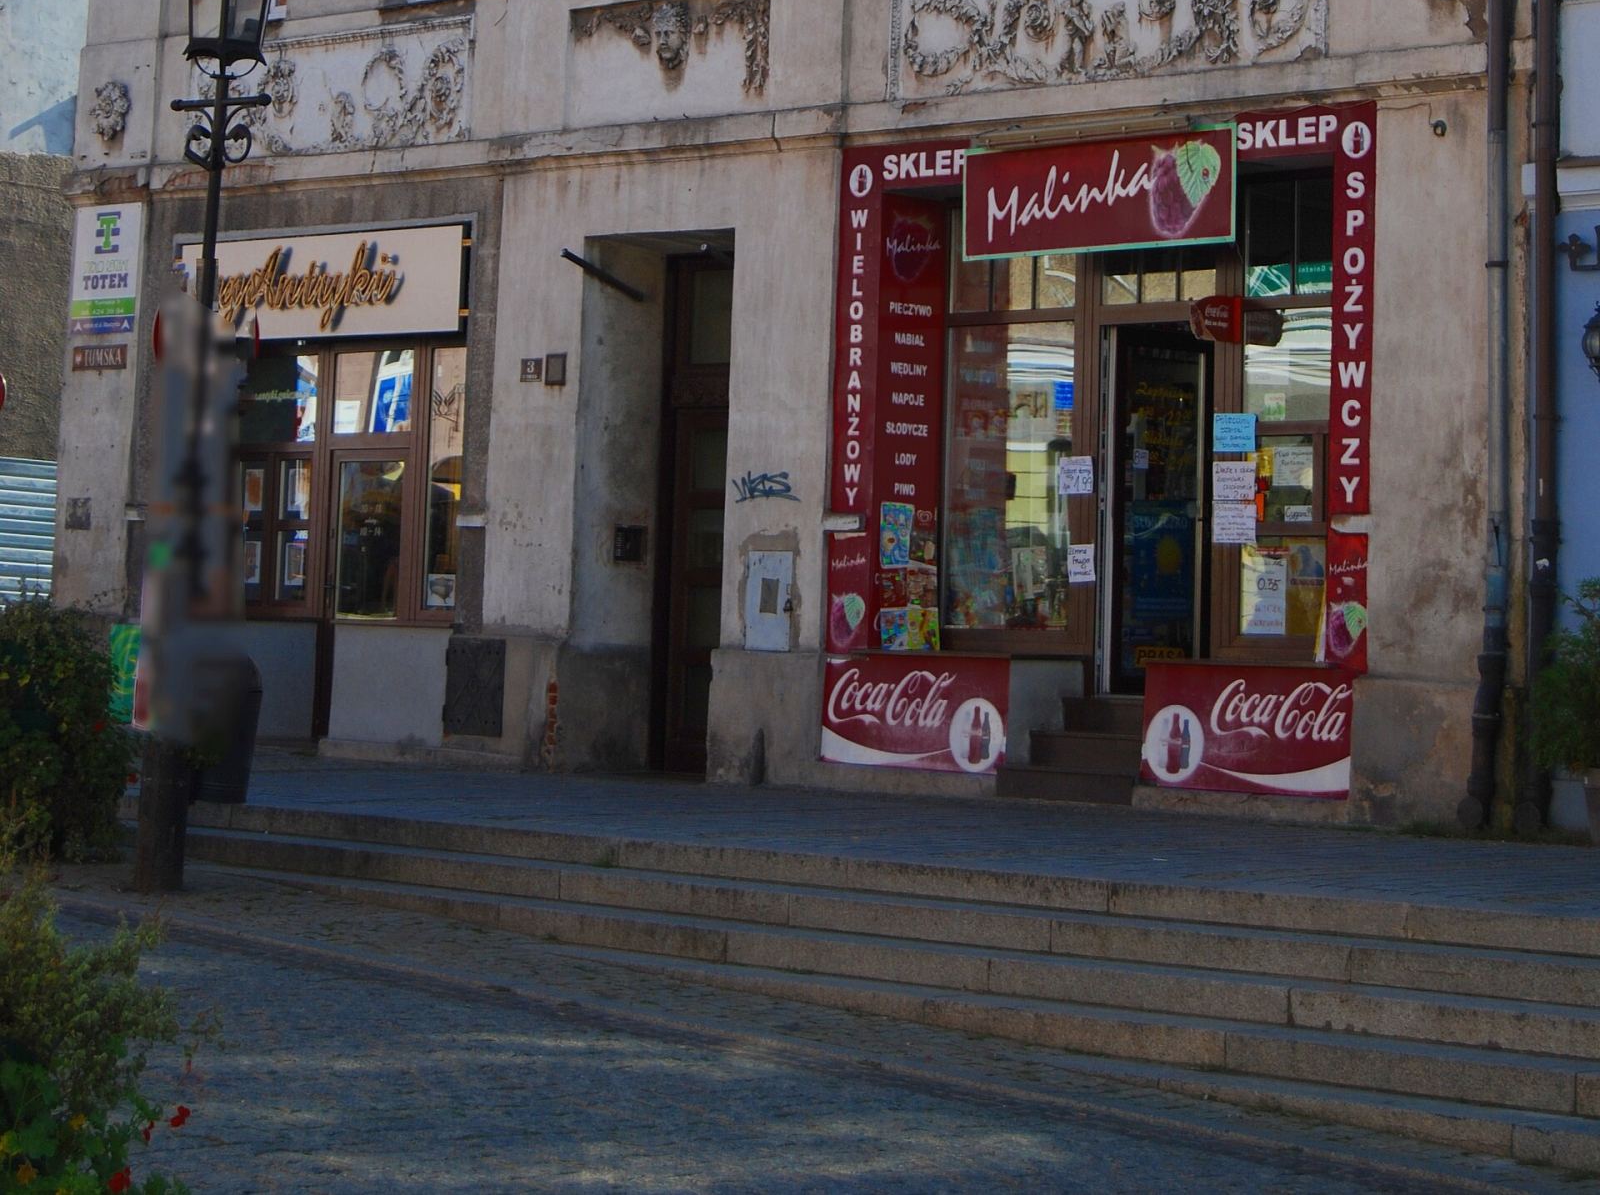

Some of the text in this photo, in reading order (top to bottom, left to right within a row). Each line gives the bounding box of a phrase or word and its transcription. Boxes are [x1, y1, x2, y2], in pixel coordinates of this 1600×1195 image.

[1237, 114, 1338, 150] SKLEP
[987, 149, 1156, 243] Malinka
[886, 234, 941, 257] Malinka
[82, 273, 129, 291] TOTEM
[889, 301, 932, 317] PIECZYWO
[894, 332, 925, 347] NABIAŁ
[1338, 171, 1366, 503] SPOŻYWCZY
[84, 348, 122, 366] TUMSKA
[843, 209, 869, 506] WIELOBRANŻOWY
[527, 360, 535, 373] 3
[890, 362, 928, 377] WĘDLINY
[891, 391, 925, 406] NAPOJE
[885, 421, 928, 437] SŁODYCZE
[894, 452, 917, 466] LODY
[894, 483, 916, 496] PIWO
[832, 552, 866, 570] Malinka
[1330, 557, 1368, 575] Malinka
